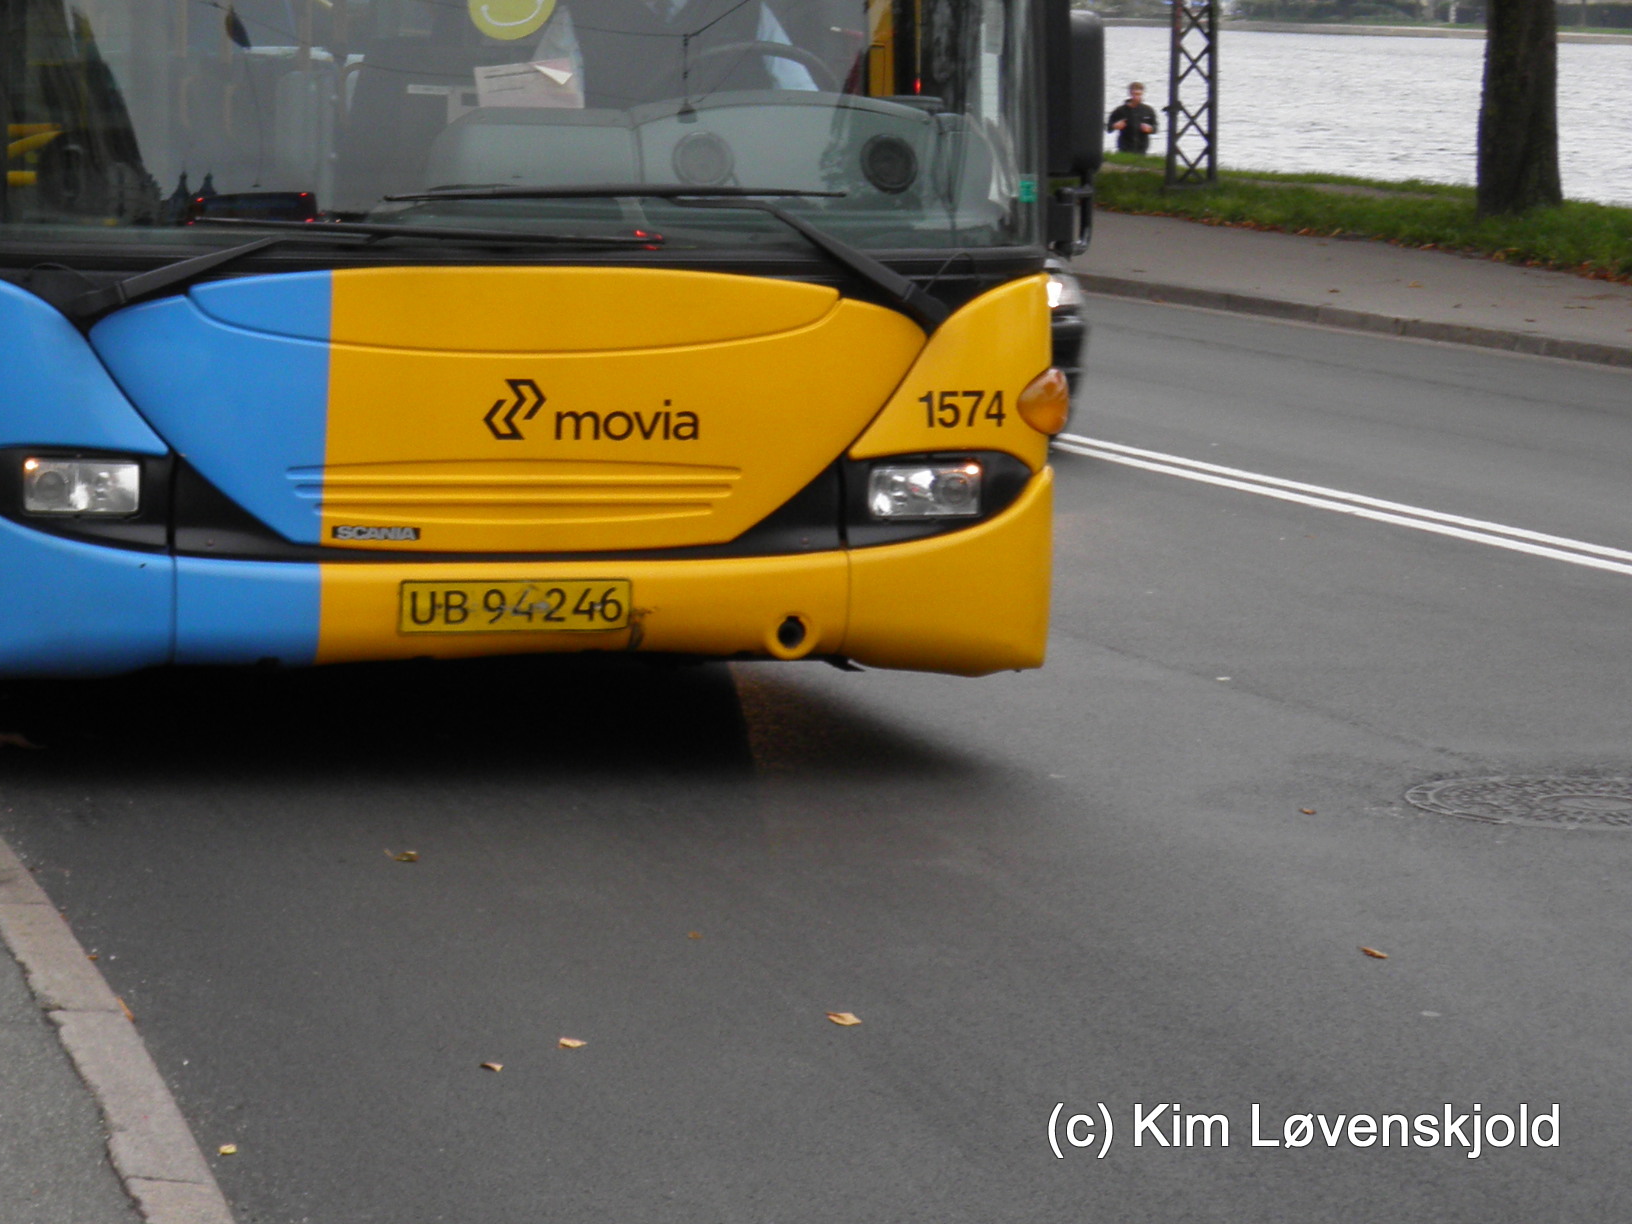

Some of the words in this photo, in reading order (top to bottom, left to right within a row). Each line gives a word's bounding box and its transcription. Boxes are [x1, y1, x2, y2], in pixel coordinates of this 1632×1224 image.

[554, 398, 701, 441] movia
[918, 389, 1007, 429] 1574
[335, 525, 417, 541] SCANIA
[410, 589, 469, 626] UB
[482, 586, 624, 625] 94246
